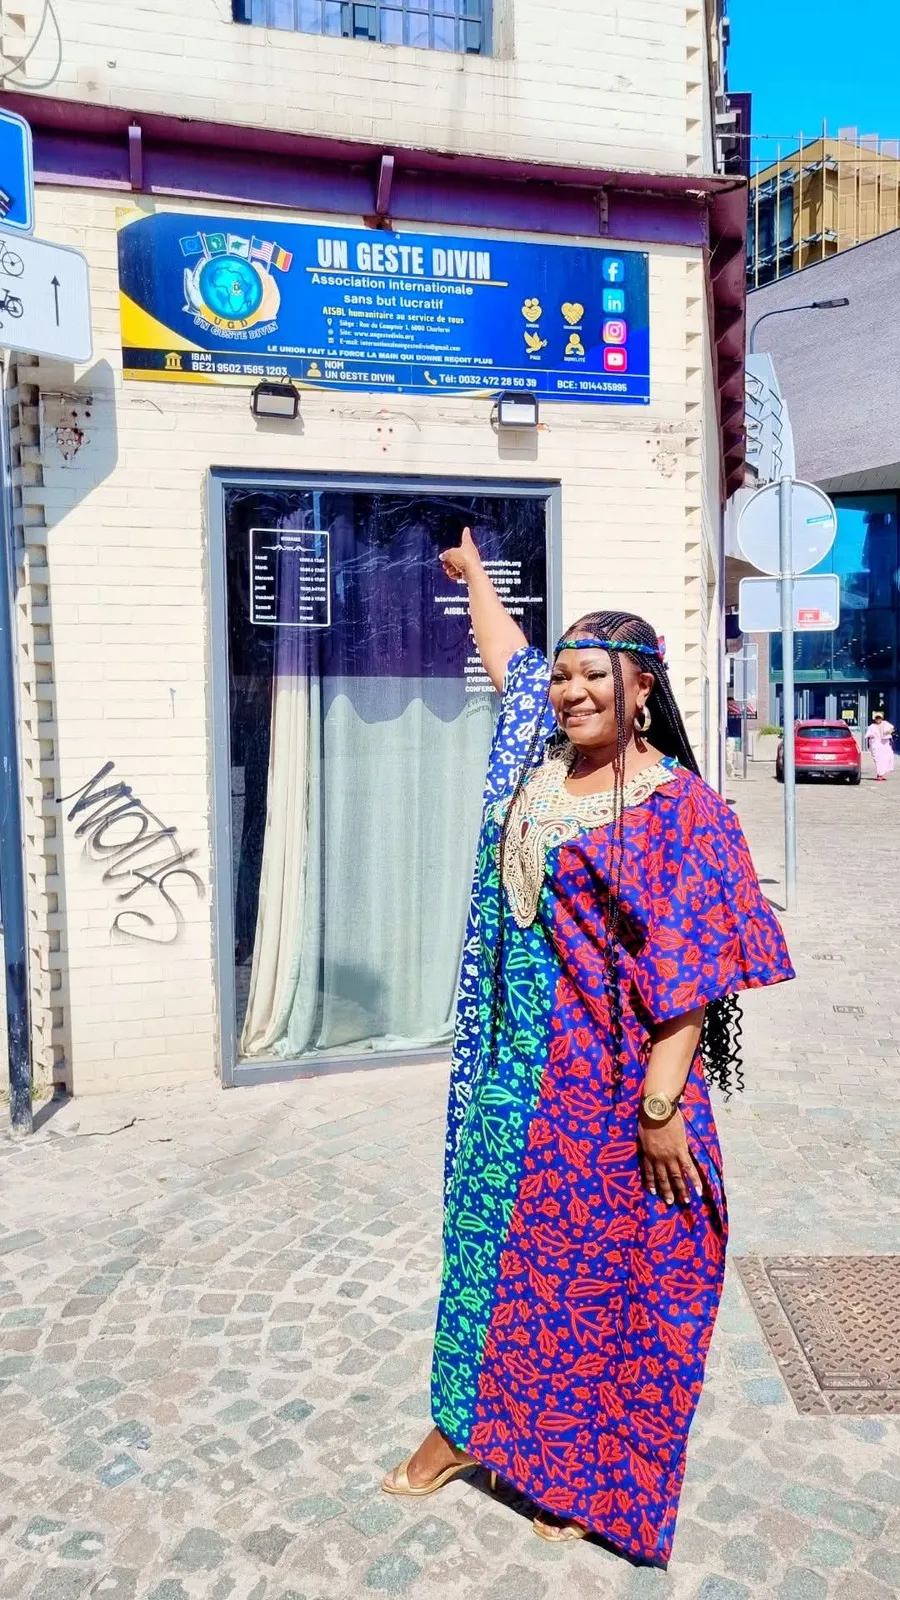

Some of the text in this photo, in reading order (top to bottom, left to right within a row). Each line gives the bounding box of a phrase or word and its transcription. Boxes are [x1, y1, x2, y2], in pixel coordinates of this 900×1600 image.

[317, 238, 491, 280] UN GESTE DIVIN
[311, 272, 474, 296] Association Internationale
[343, 294, 444, 310] sans but lucratif
[213, 316, 249, 329] U G D
[322, 306, 346, 317] AISBL
[348, 308, 394, 320] humanitaire
[407, 313, 435, 323] service
[436, 315, 446, 323] de
[448, 316, 465, 325] tous
[193, 315, 279, 341] UN GESTE DIVIN
[191, 352, 212, 361] IBAN
[266, 344, 278, 352] LE
[279, 345, 306, 354] UNION
[307, 347, 326, 356] FAIT
[327, 348, 338, 356] LA
[339, 349, 365, 358] FORCE
[366, 351, 378, 359] LA
[378, 352, 399, 360] MAIN
[399, 353, 415, 361] QUI
[415, 354, 443, 363] DONNE
[473, 357, 494, 365] PLUS
[191, 361, 288, 377] BE21 9502 1585 1203
[324, 360, 344, 370] NOM
[324, 370, 396, 383] UN GESTE DIVIN
[438, 373, 538, 388] Tél: 0032 472 28 50 39
[556, 379, 578, 390] BCE:
